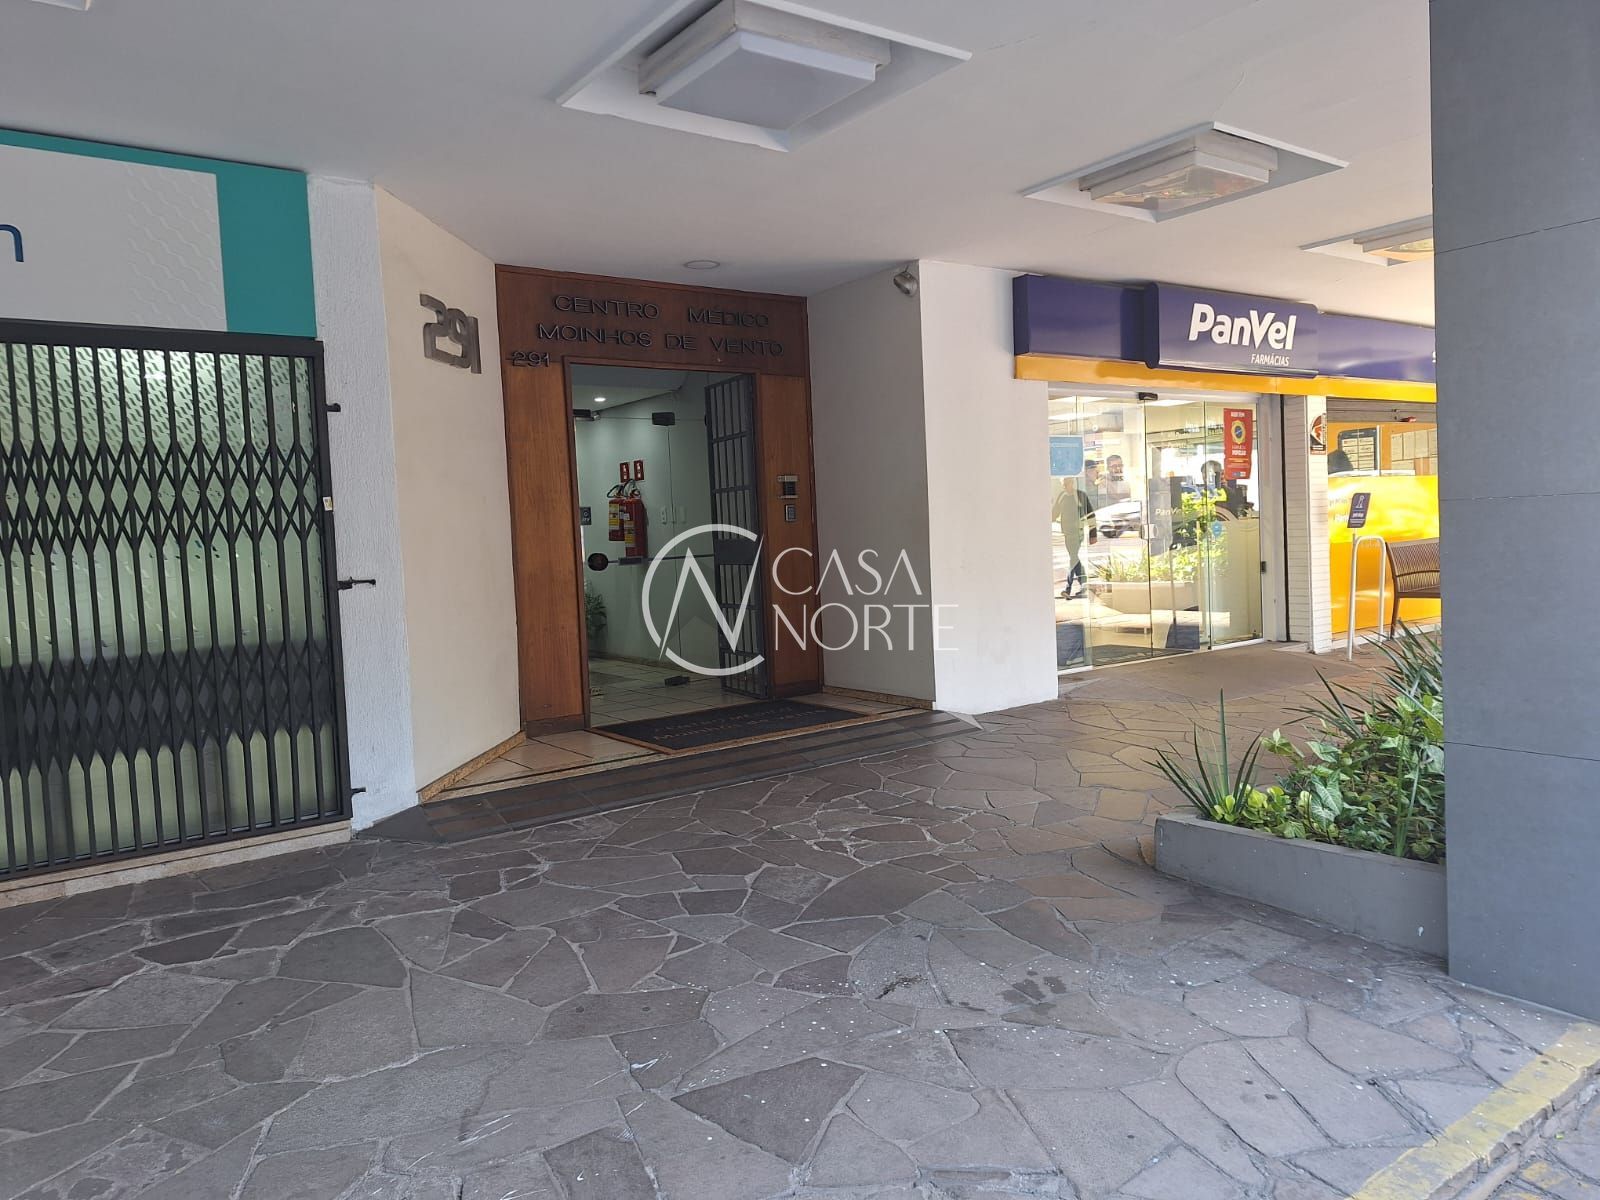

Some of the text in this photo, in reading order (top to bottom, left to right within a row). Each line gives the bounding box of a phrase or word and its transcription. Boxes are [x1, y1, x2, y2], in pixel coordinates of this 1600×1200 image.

[554, 295, 660, 319] CENTRO
[419, 293, 481, 374] 291
[537, 322, 784, 357] MOINHOS DE VENTO
[1188, 302, 1297, 351] PanVel
[510, 351, 551, 368] 291
[1250, 352, 1290, 367] FARMÁCIAS
